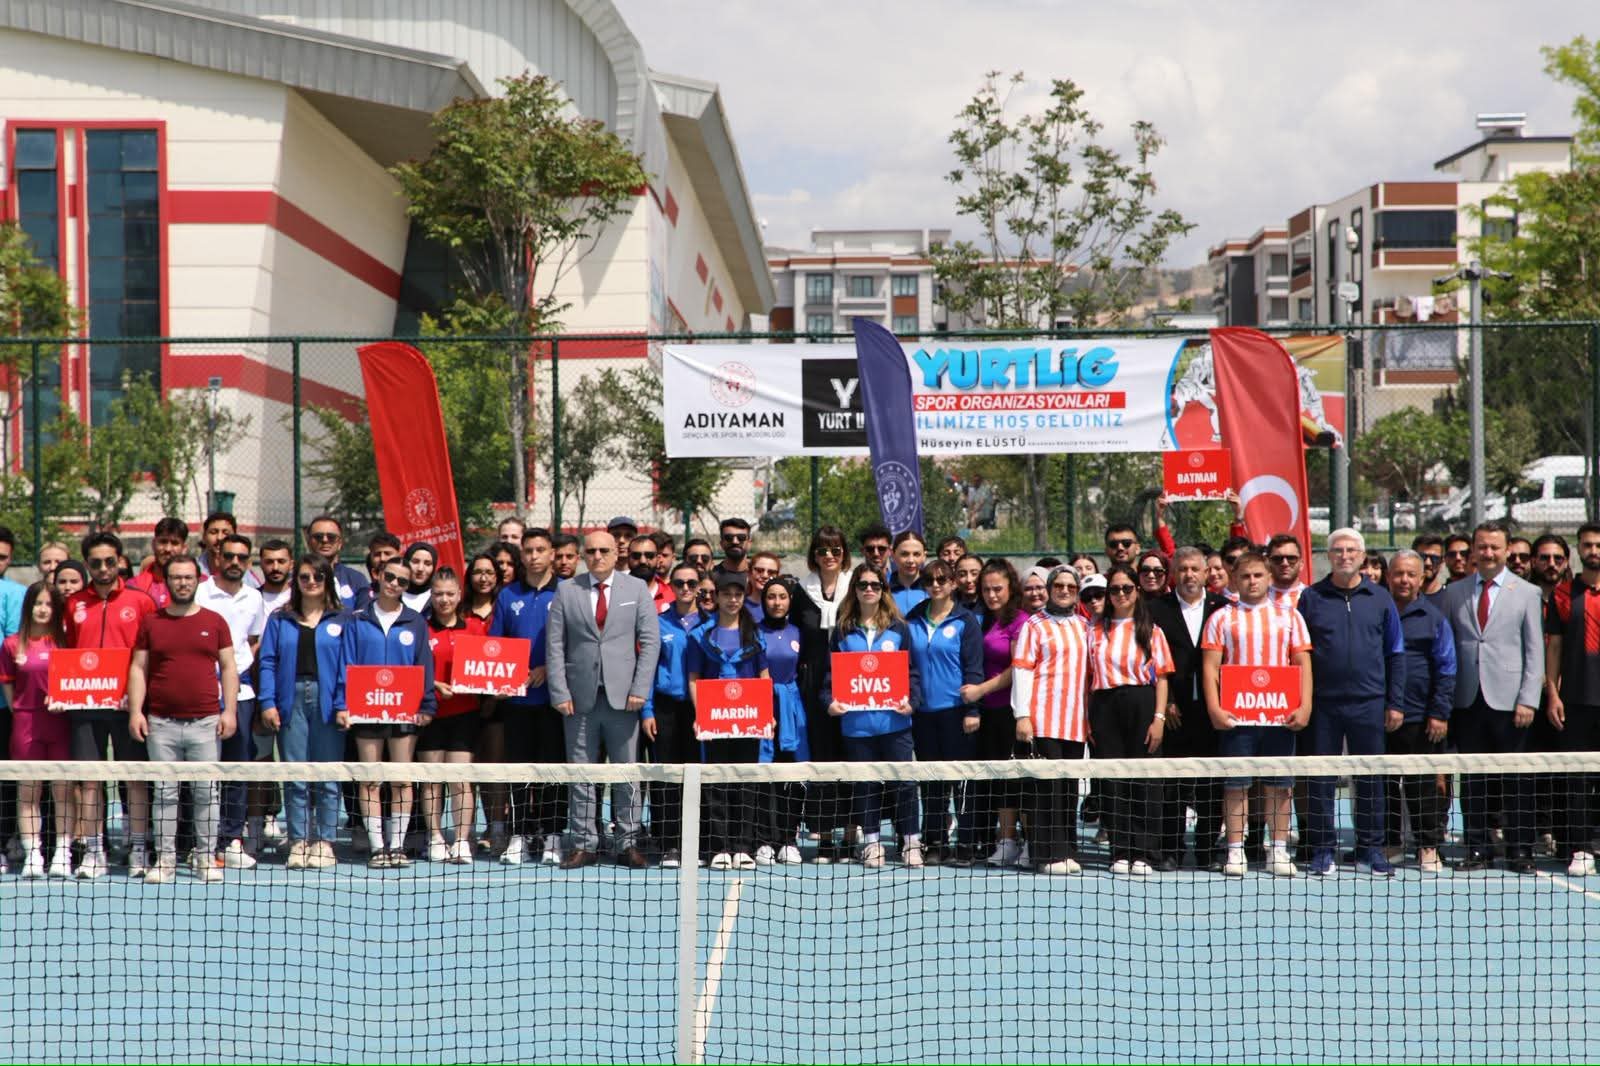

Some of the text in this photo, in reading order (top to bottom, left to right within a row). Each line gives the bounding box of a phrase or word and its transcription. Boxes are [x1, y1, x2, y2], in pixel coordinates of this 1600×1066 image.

[916, 393, 1110, 410] SPOR ORGANİZASYONLARI
[684, 412, 784, 428] ADIYAMAN
[817, 412, 852, 430] YURT
[917, 409, 1123, 431] İLİMİZE HOŞ GELDİNİZ
[921, 438, 972, 449] Hüseyin
[976, 435, 1026, 448] ELÜSTÜ
[1177, 472, 1217, 484] BATMAN
[464, 660, 516, 678] HATAY
[60, 677, 117, 691] KARAMAN
[850, 674, 890, 694] SİVAS
[365, 691, 403, 706] SİİRT
[1235, 691, 1288, 709] ADANA
[710, 704, 758, 720] MARDİN
